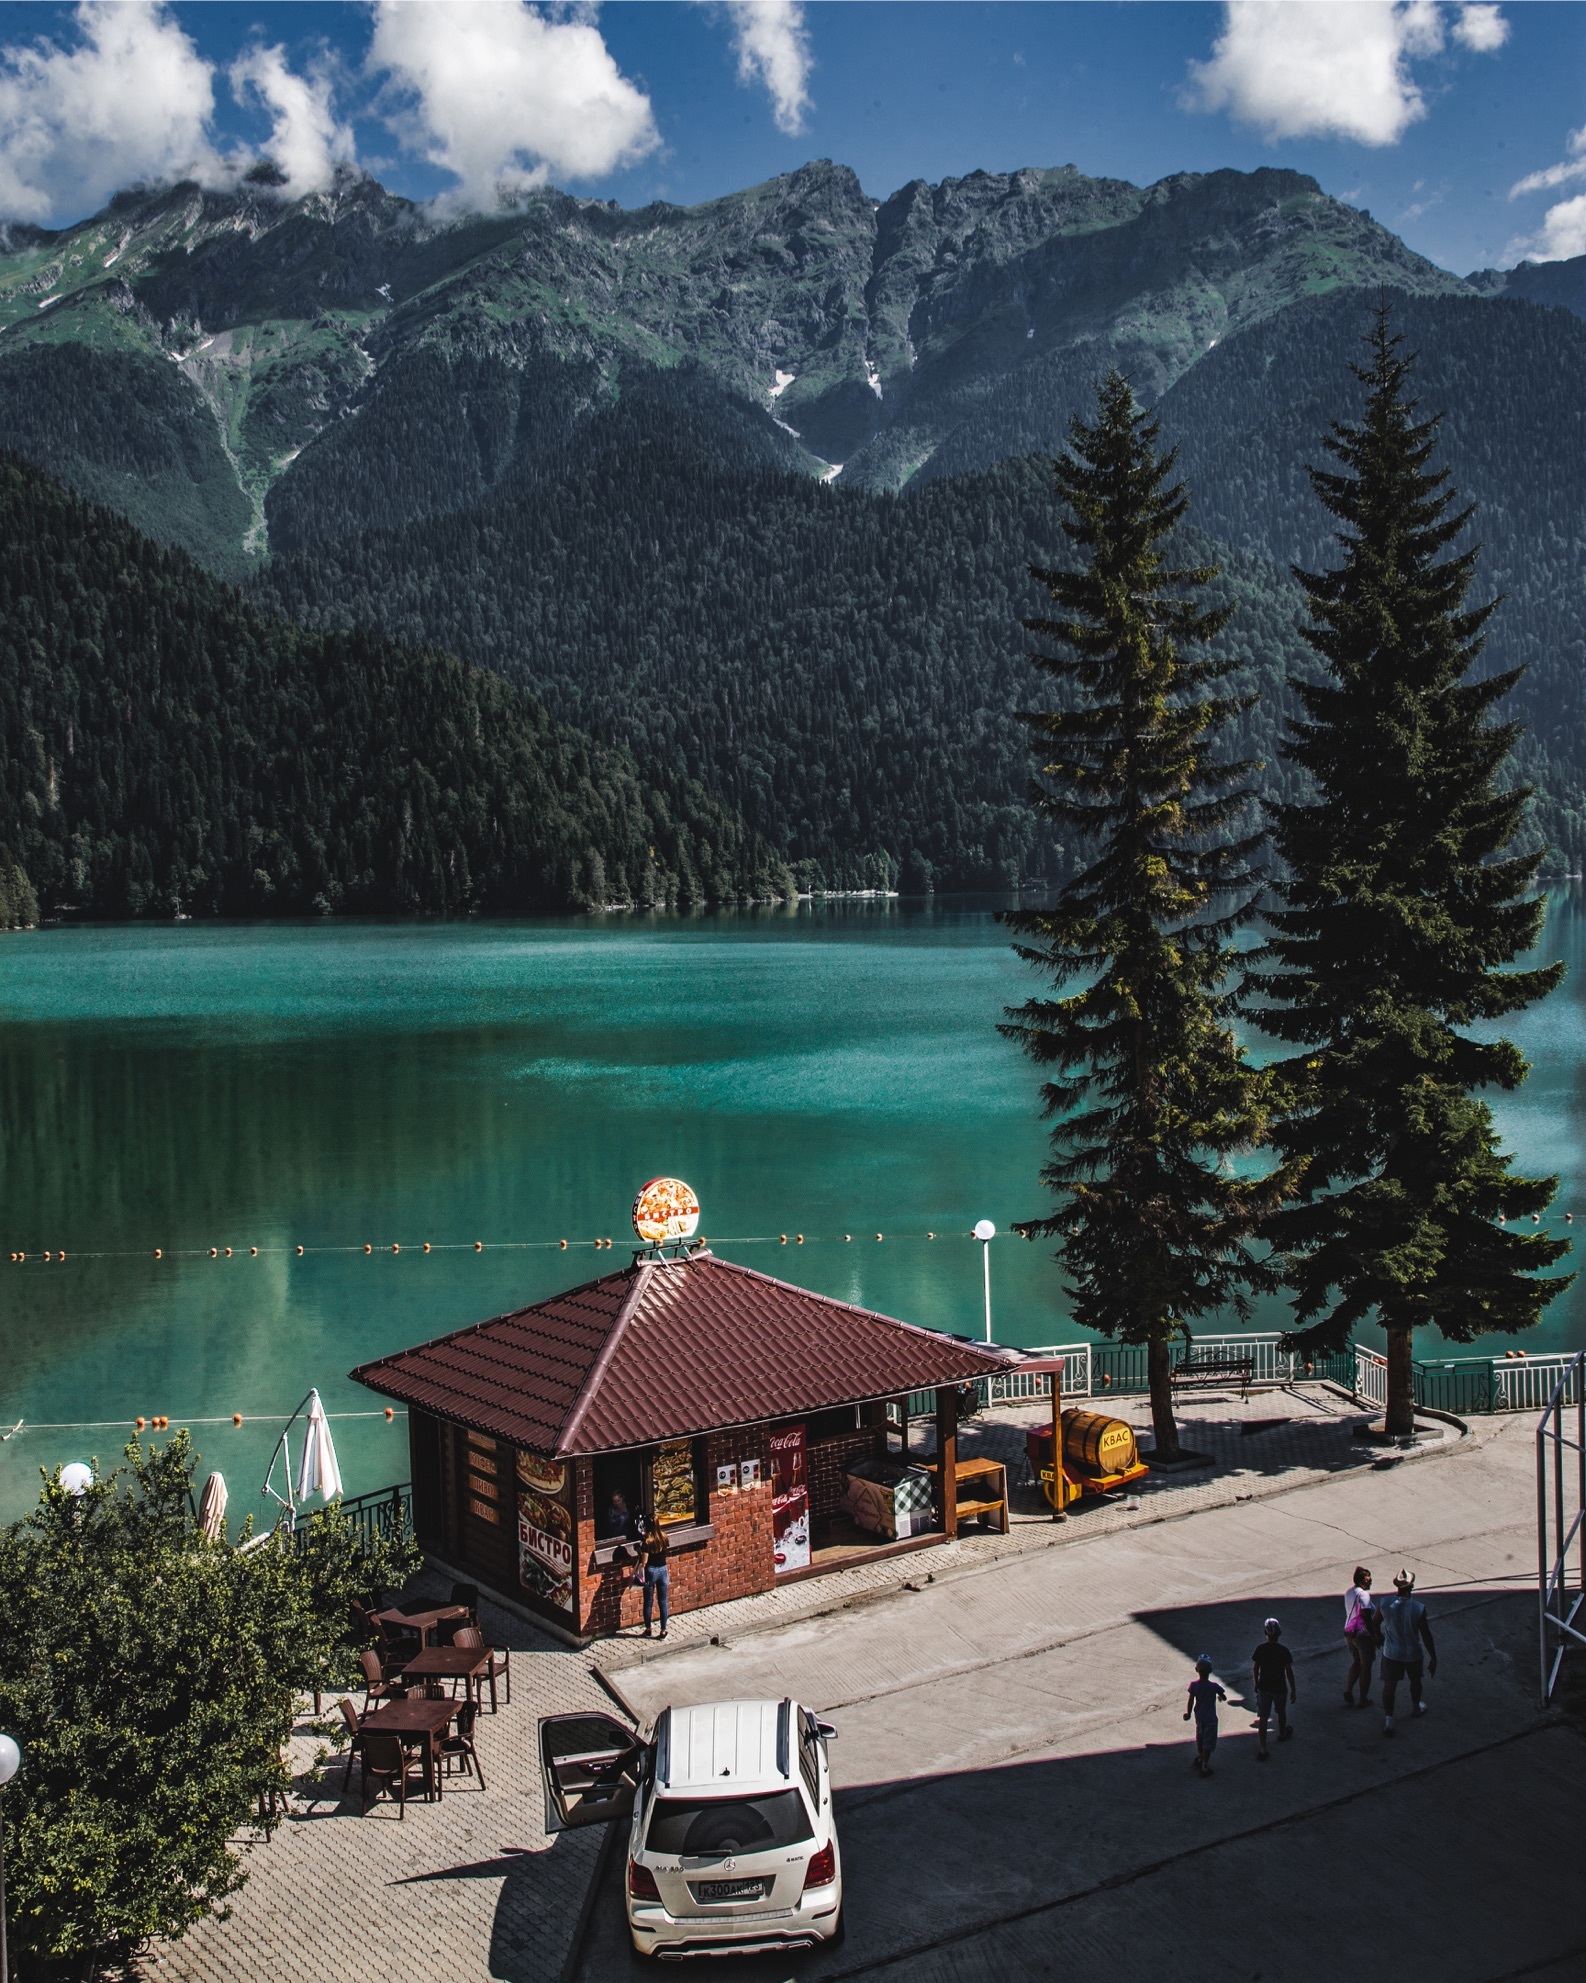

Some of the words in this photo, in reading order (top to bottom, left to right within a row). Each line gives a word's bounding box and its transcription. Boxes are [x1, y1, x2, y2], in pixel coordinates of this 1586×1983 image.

[645, 1208, 692, 1220] БИСТРО
[1103, 1430, 1128, 1448] КВАС
[474, 1499, 494, 1521] КВАС
[520, 1523, 570, 1564] БИСТРО
